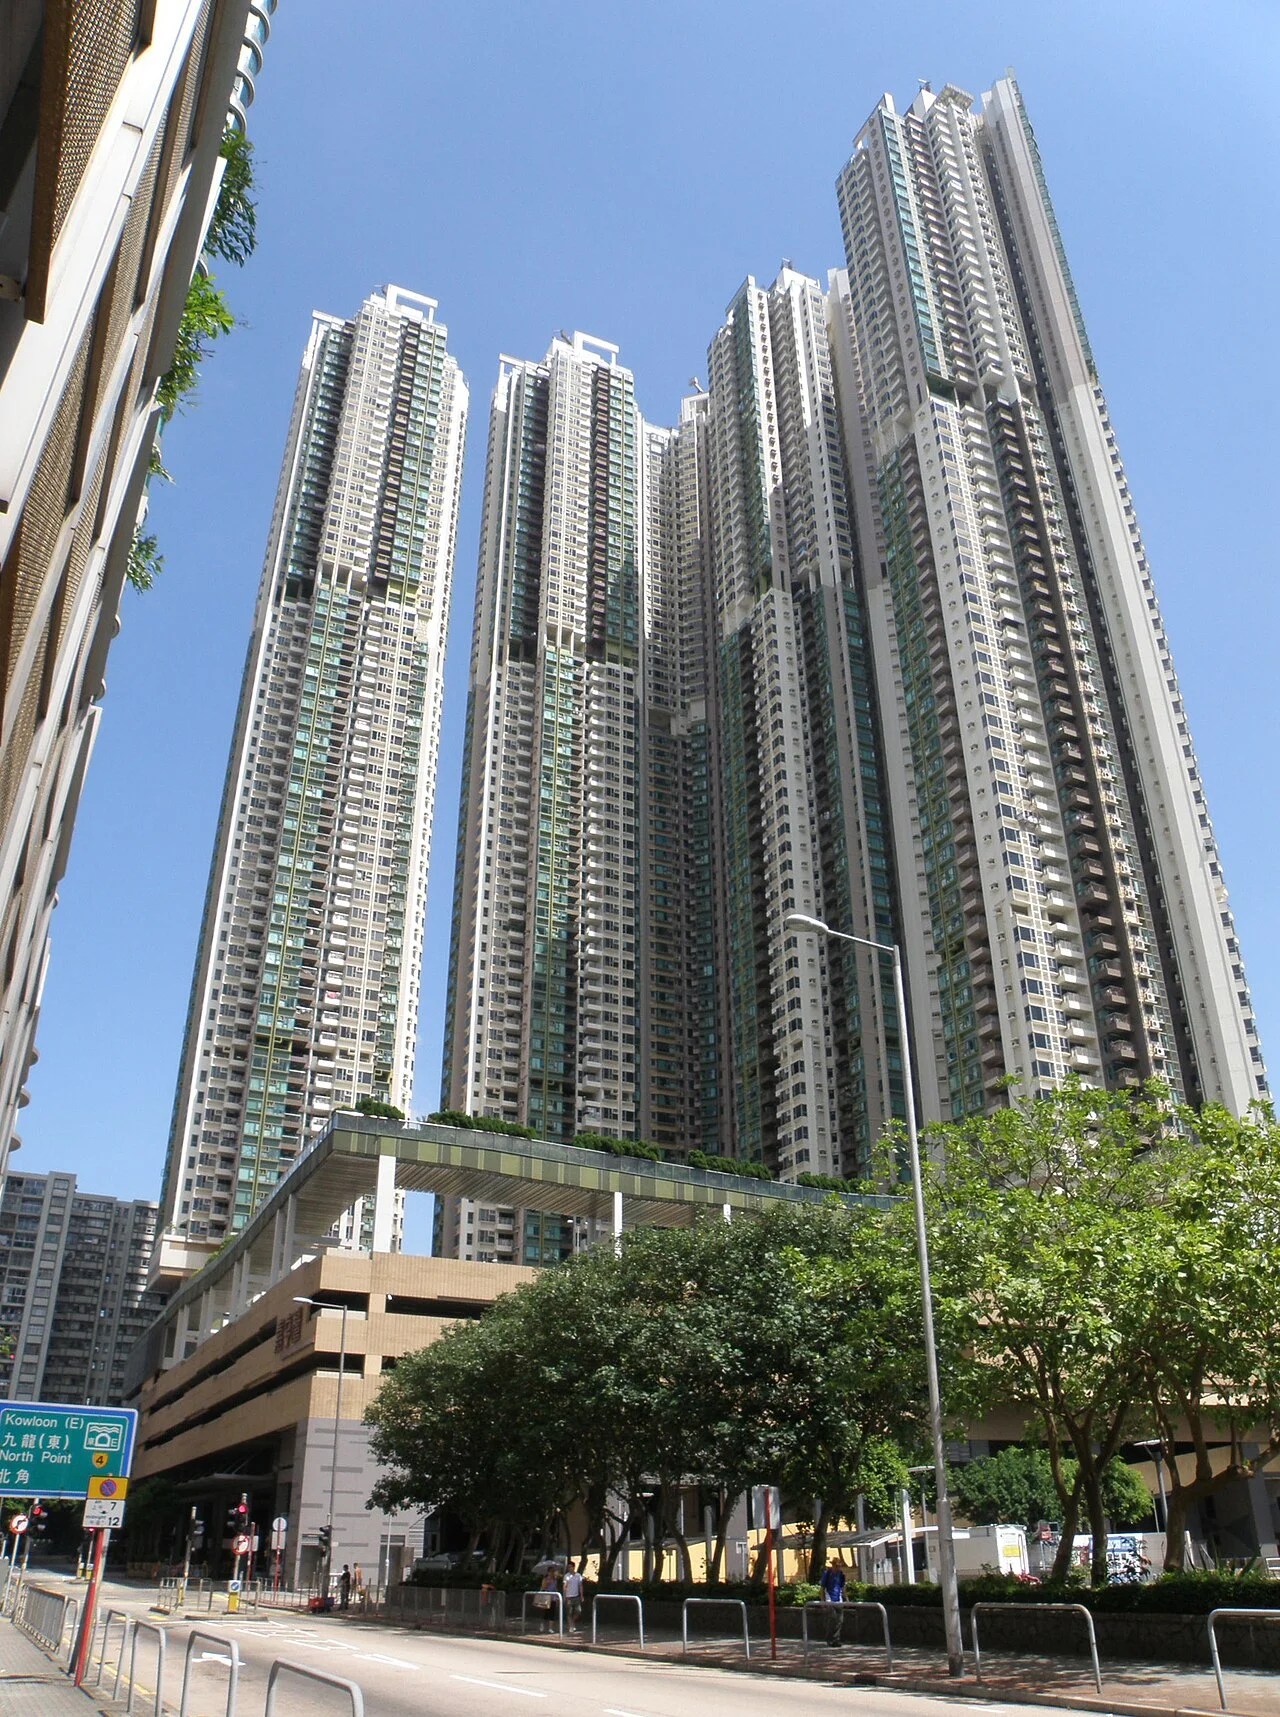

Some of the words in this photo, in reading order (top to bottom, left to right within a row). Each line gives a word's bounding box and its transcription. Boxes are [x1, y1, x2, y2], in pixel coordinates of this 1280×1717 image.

[5, 1413, 58, 1428] Kowloon
[65, 1417, 84, 1430] (E)
[111, 1438, 118, 1447] E
[0, 1449, 34, 1462] North
[41, 1451, 72, 1464] Point
[95, 1455, 104, 1465] 4
[0, 1468, 29, 1484] 北角
[110, 1502, 117, 1511] 7
[108, 1517, 120, 1526] 12
